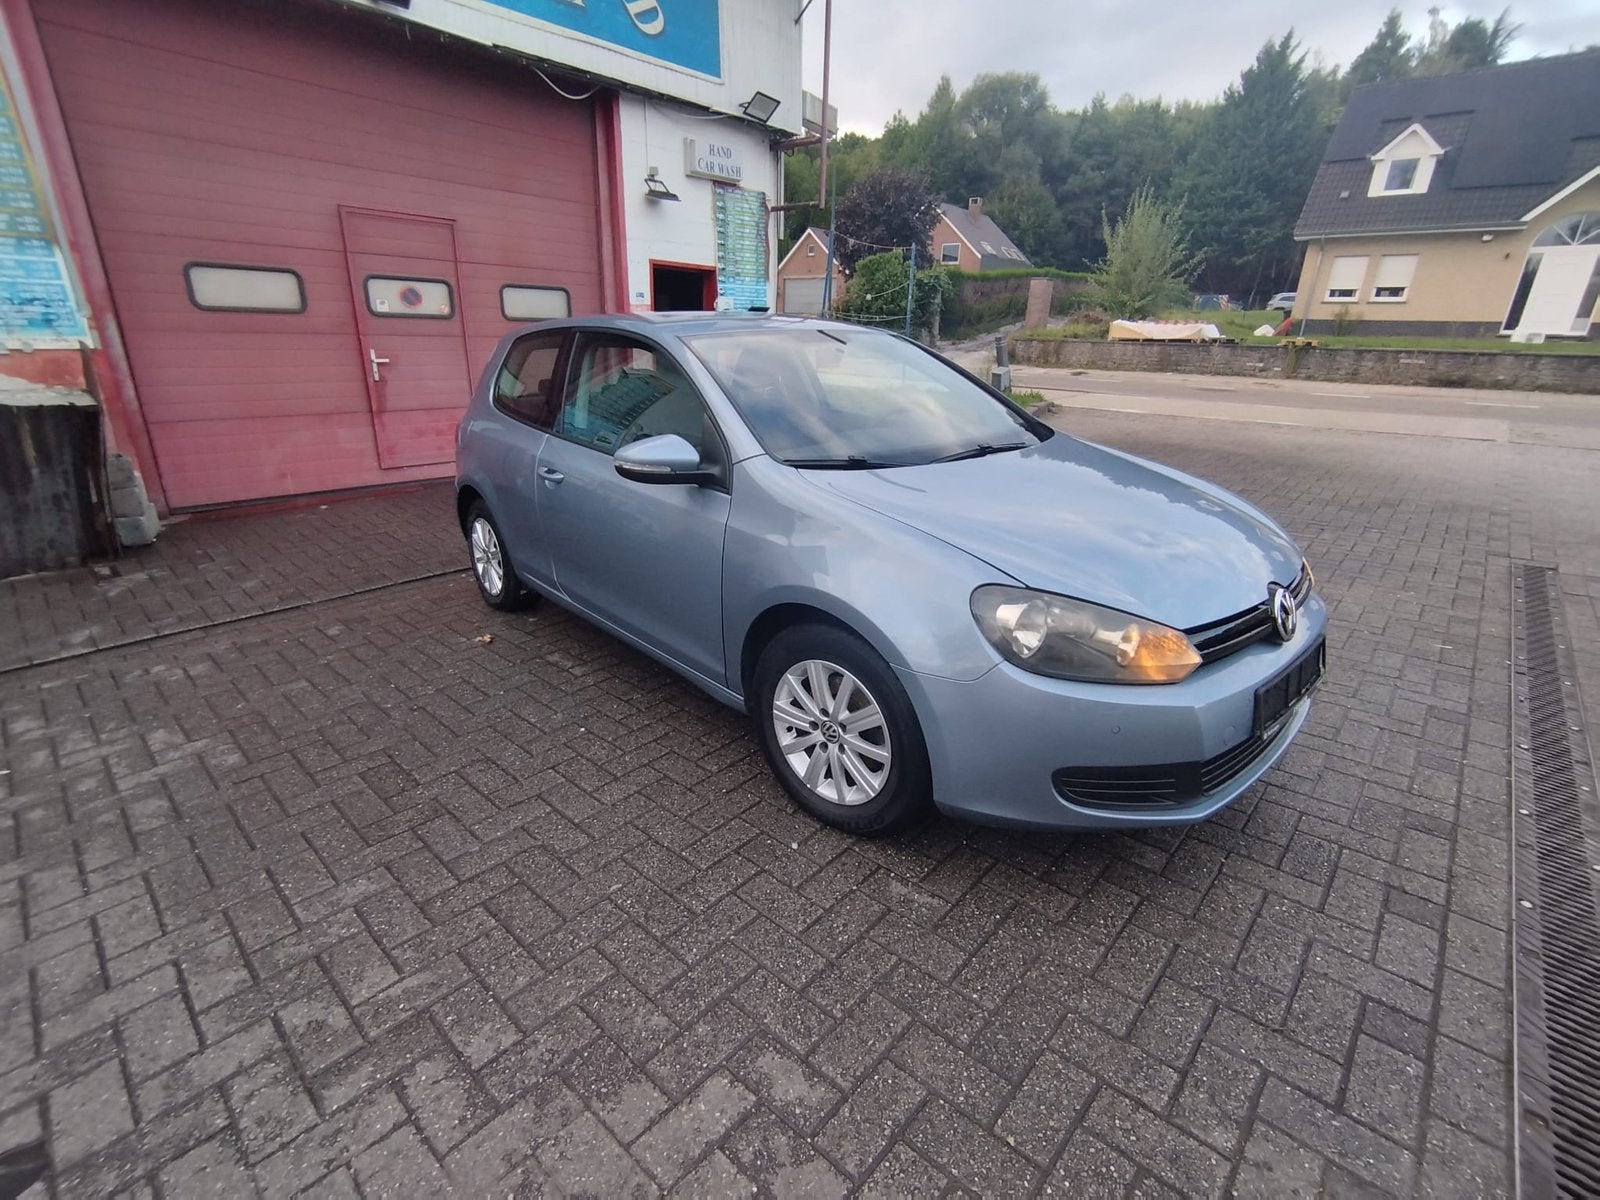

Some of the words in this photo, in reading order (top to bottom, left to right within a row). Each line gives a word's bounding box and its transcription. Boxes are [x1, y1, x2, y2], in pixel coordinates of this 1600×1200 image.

[709, 143, 732, 159] HAND
[697, 157, 715, 173] CAR
[717, 163, 742, 178] WASH
